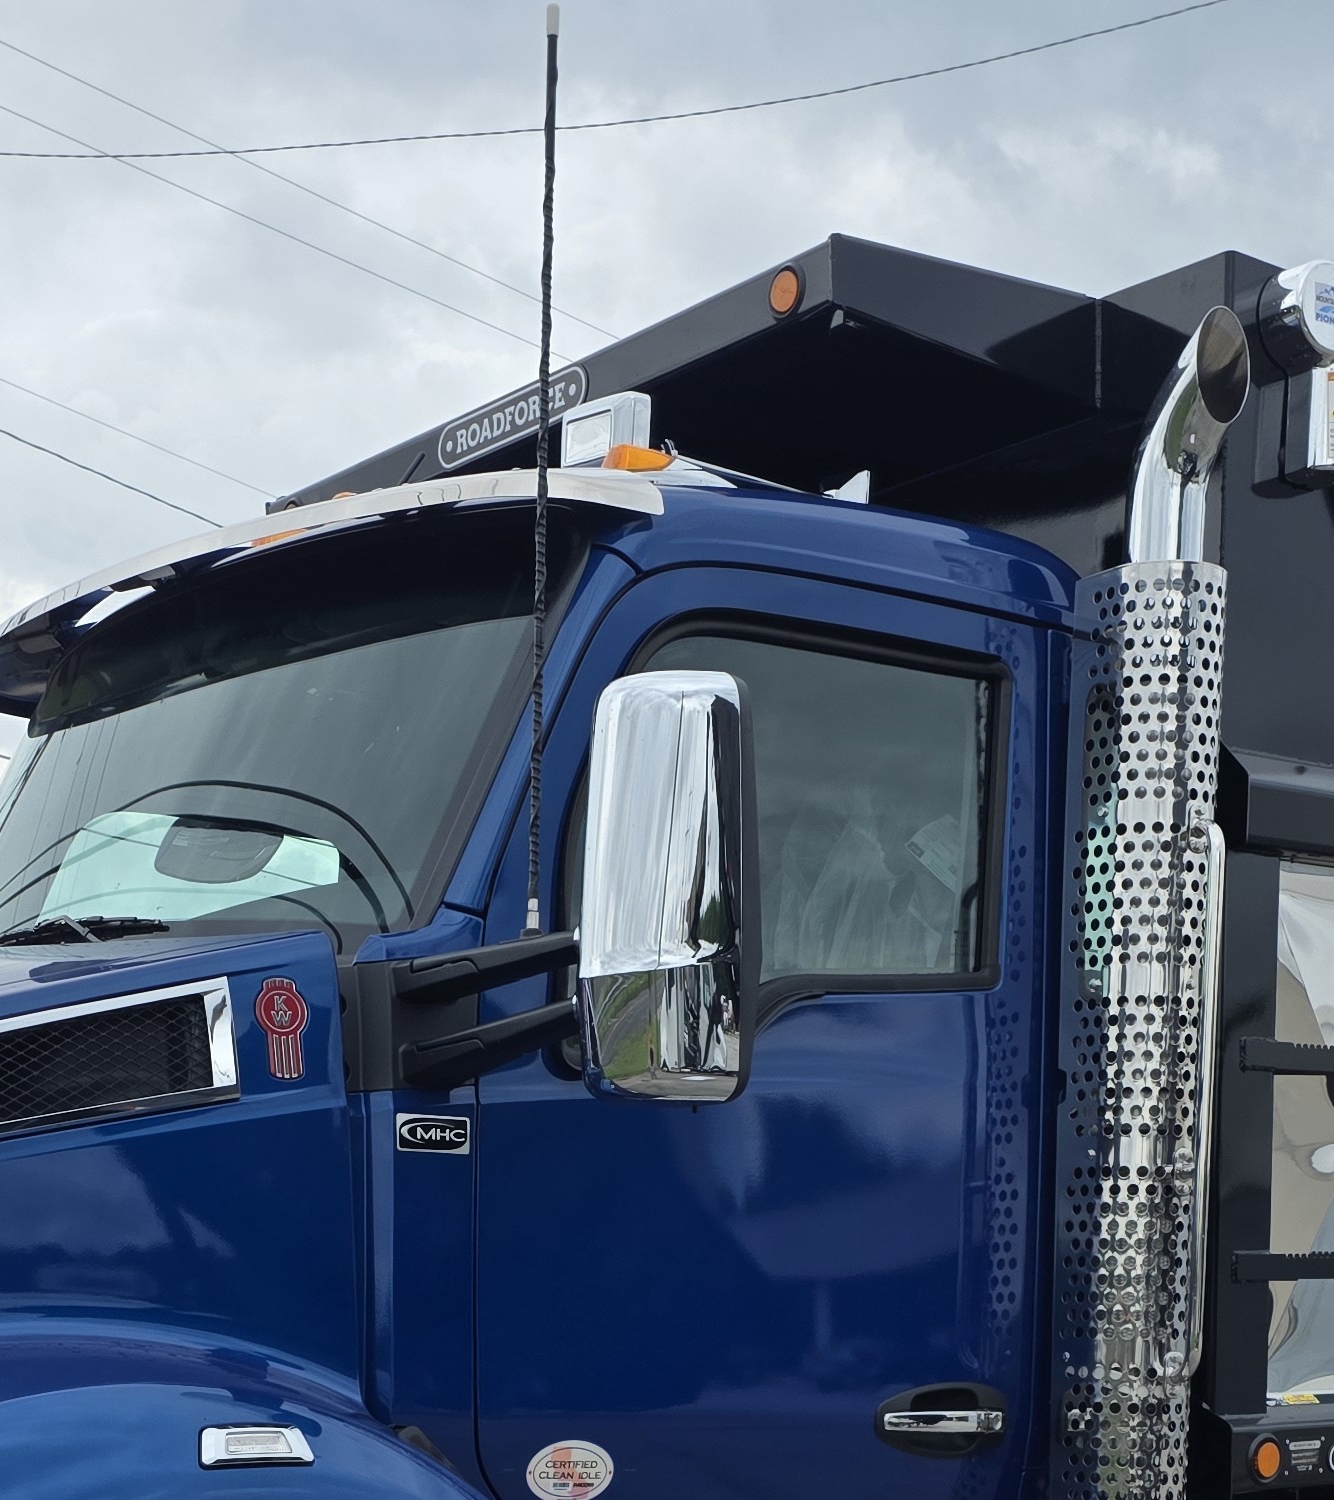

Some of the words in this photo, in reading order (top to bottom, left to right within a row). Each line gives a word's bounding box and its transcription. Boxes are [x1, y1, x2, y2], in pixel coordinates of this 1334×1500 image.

[545, 1460, 598, 1469] CERTIFIED
[538, 1471, 574, 1480] CLEAN
[578, 1471, 601, 1480] IDLE
